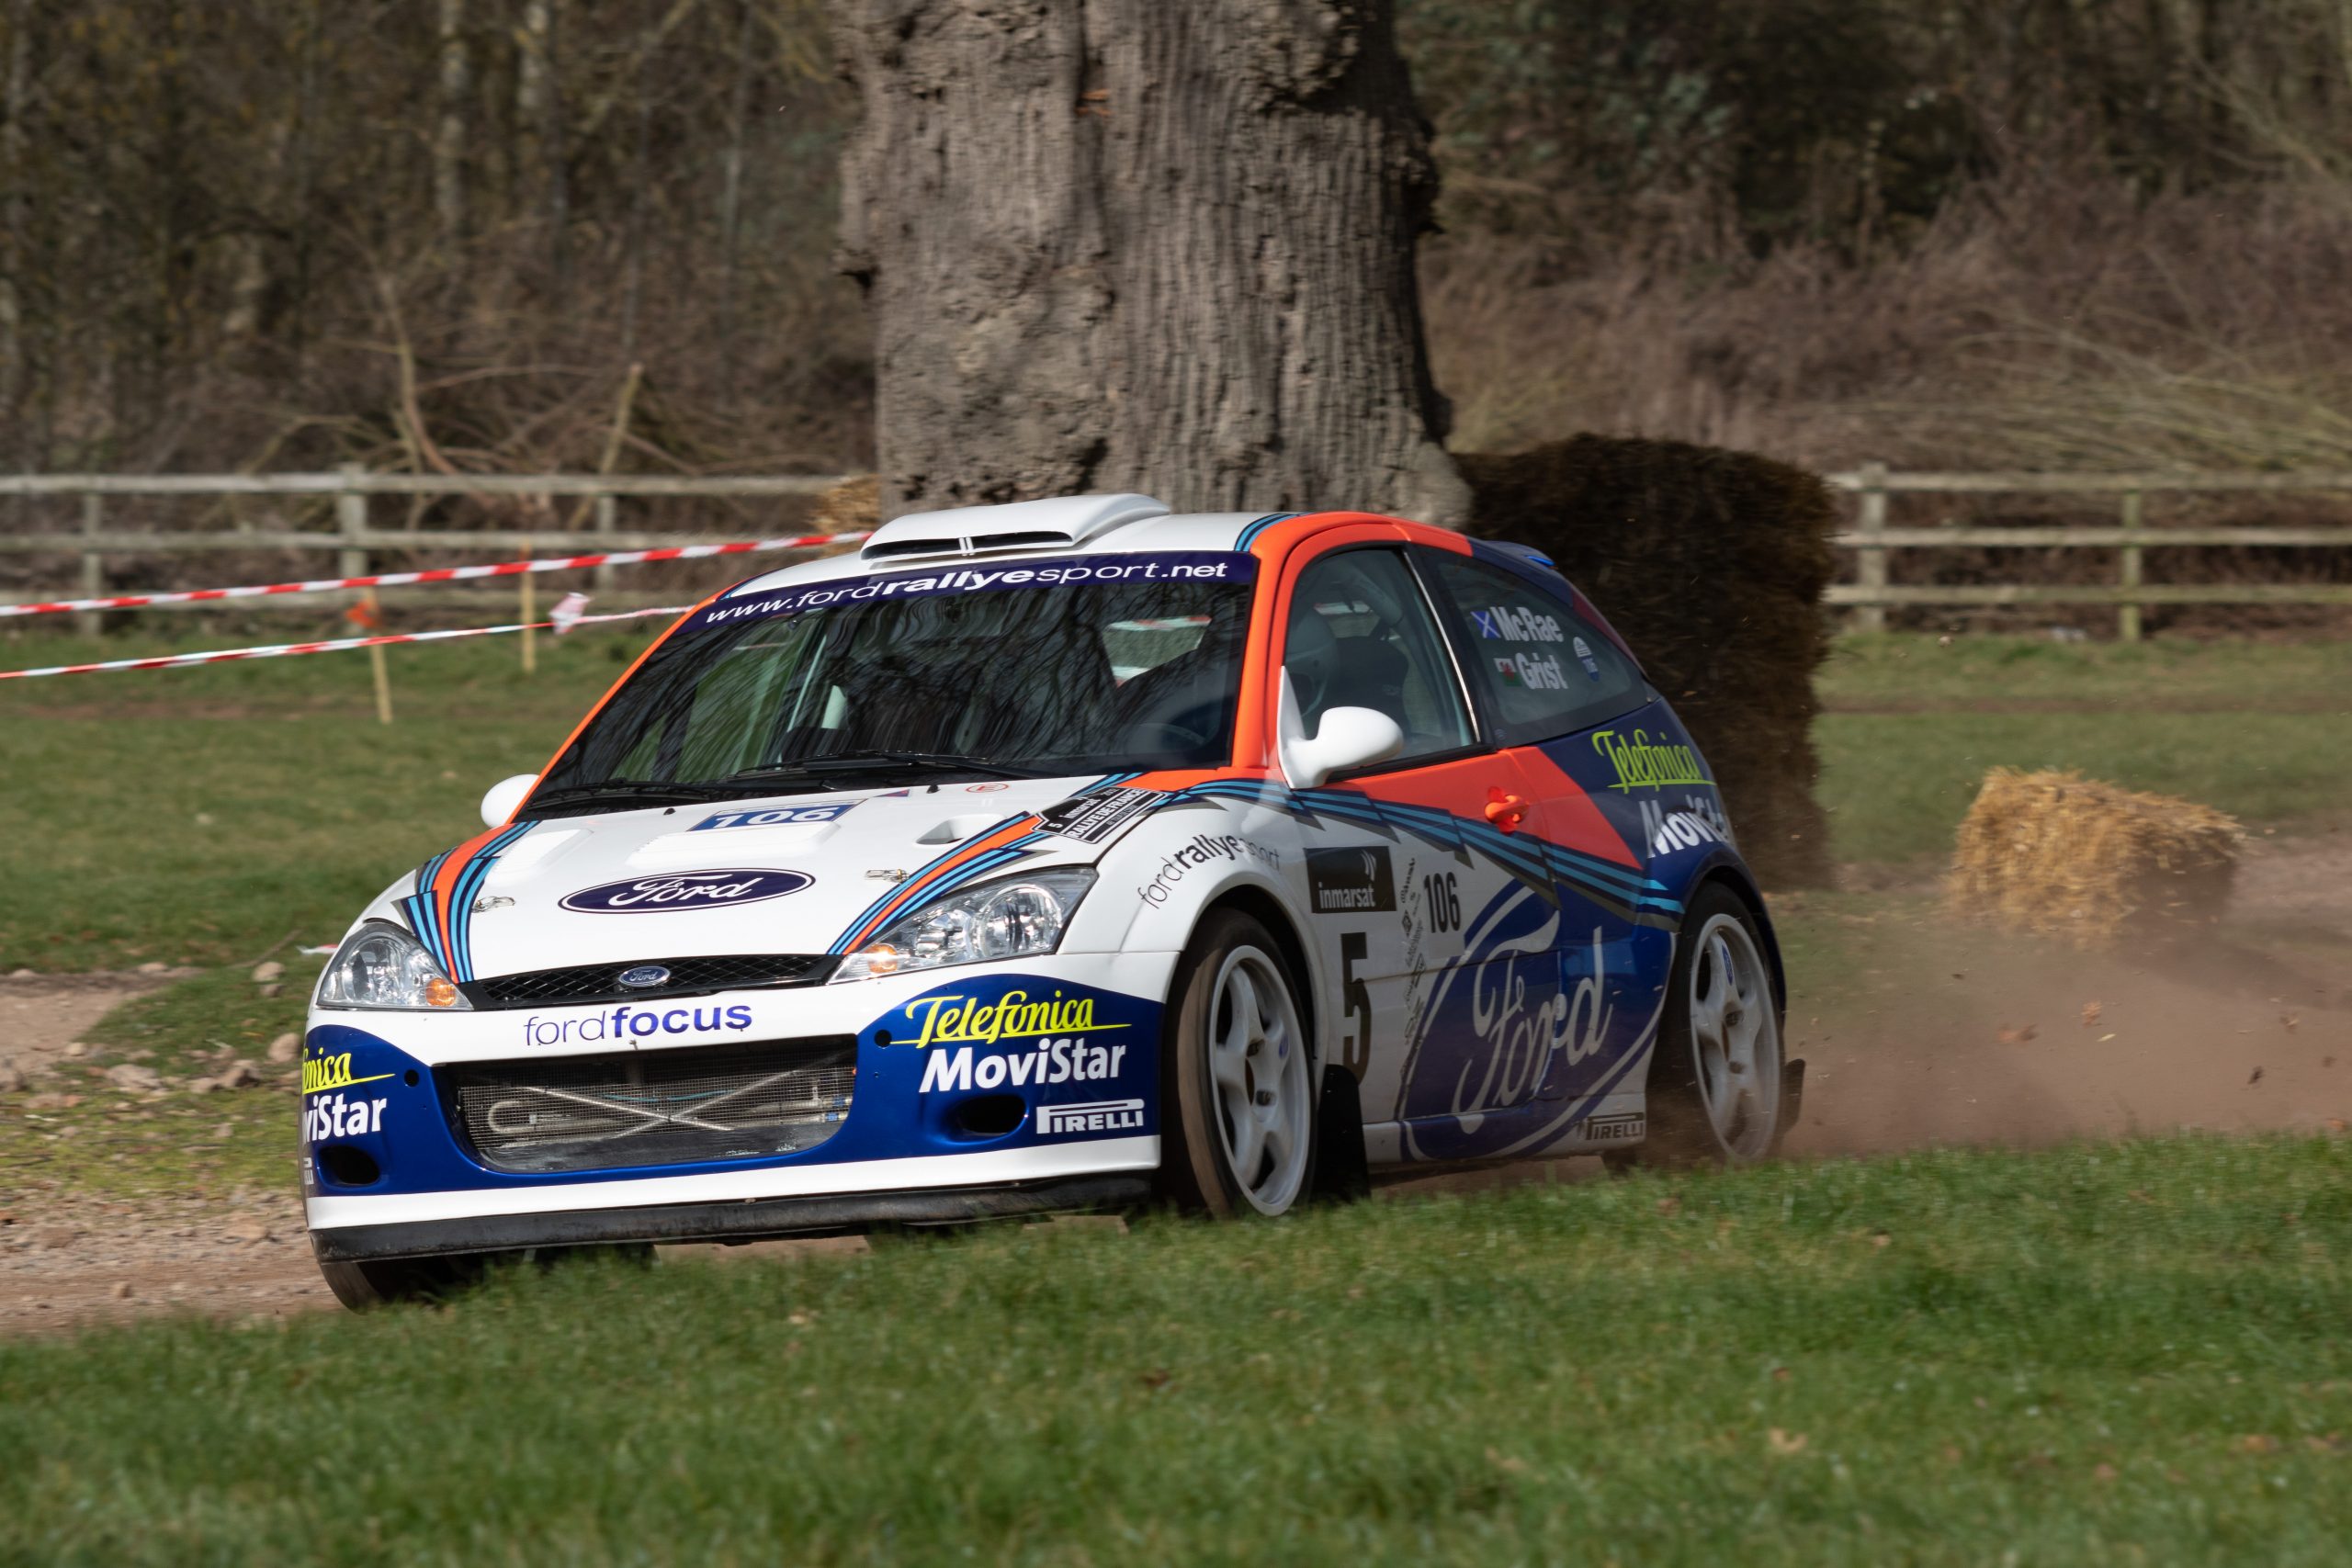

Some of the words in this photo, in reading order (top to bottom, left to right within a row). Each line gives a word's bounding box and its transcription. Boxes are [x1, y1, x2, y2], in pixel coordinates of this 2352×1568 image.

[706, 562, 1227, 625] www.fordrallyesport.net
[1489, 606, 1564, 642] McRae
[1515, 652, 1568, 690] Grist
[712, 807, 840, 829] 106
[1066, 814, 1106, 839] RALLYE
[1094, 807, 1116, 818] DE
[1105, 788, 1147, 809] FRANCE
[607, 873, 765, 907] Ford
[1317, 881, 1376, 909] inmarsat
[1423, 871, 1461, 934] 106
[523, 1005, 753, 1046] fordfocus
[1340, 931, 1372, 1086] 5
[1451, 909, 1614, 1134] Ford
[919, 1037, 1126, 1093] MoviStar
[1035, 1098, 1145, 1134] PIRELLI
[1585, 1111, 1645, 1141] PIRELLI
